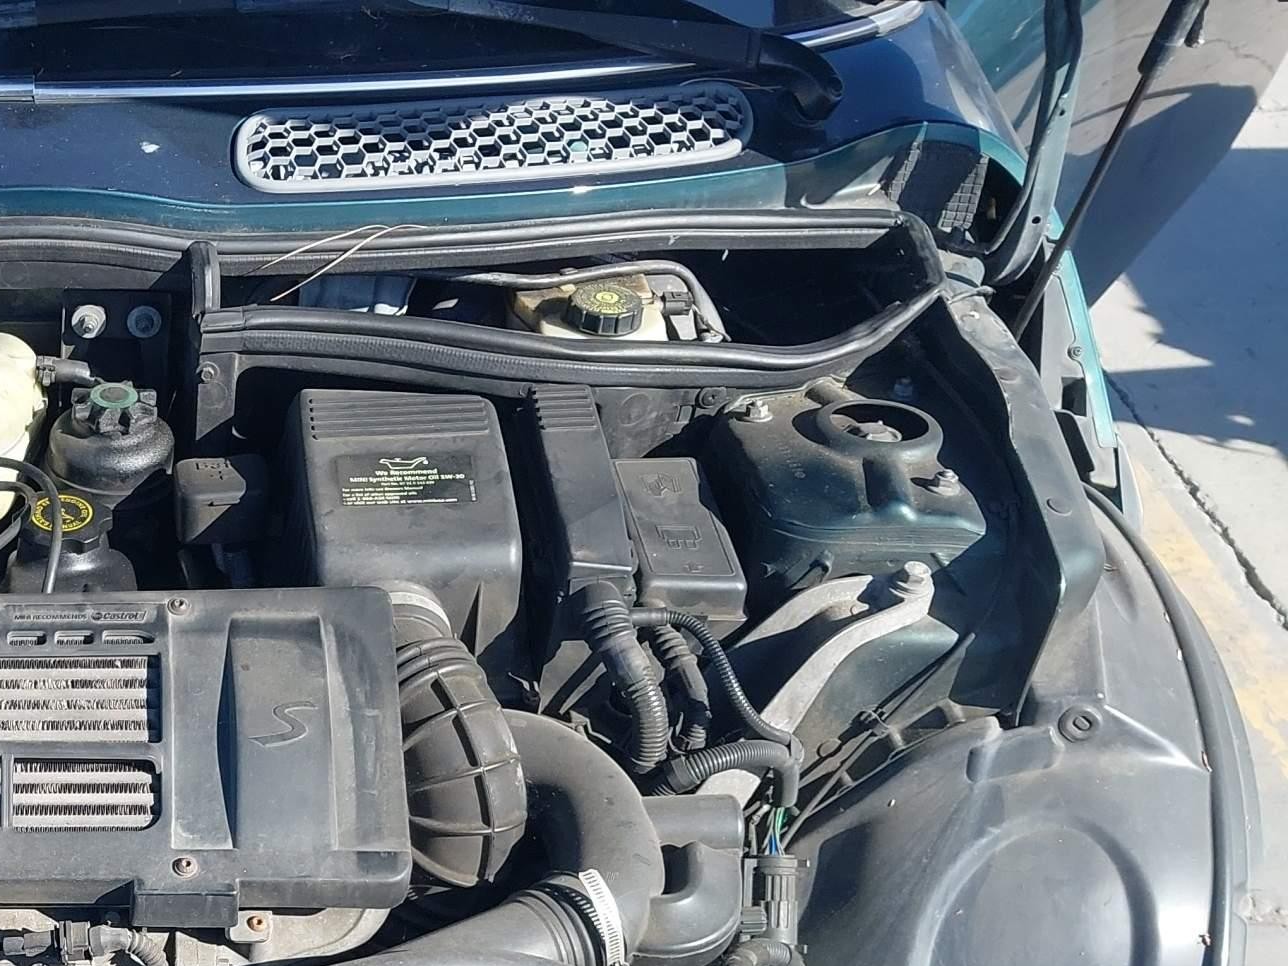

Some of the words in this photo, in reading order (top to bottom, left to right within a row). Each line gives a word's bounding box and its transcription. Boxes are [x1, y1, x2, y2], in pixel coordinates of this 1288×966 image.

[390, 468, 438, 476] Recommend
[369, 476, 403, 484] Synthetic
[102, 611, 140, 621] Castrol
[247, 700, 317, 748] S
